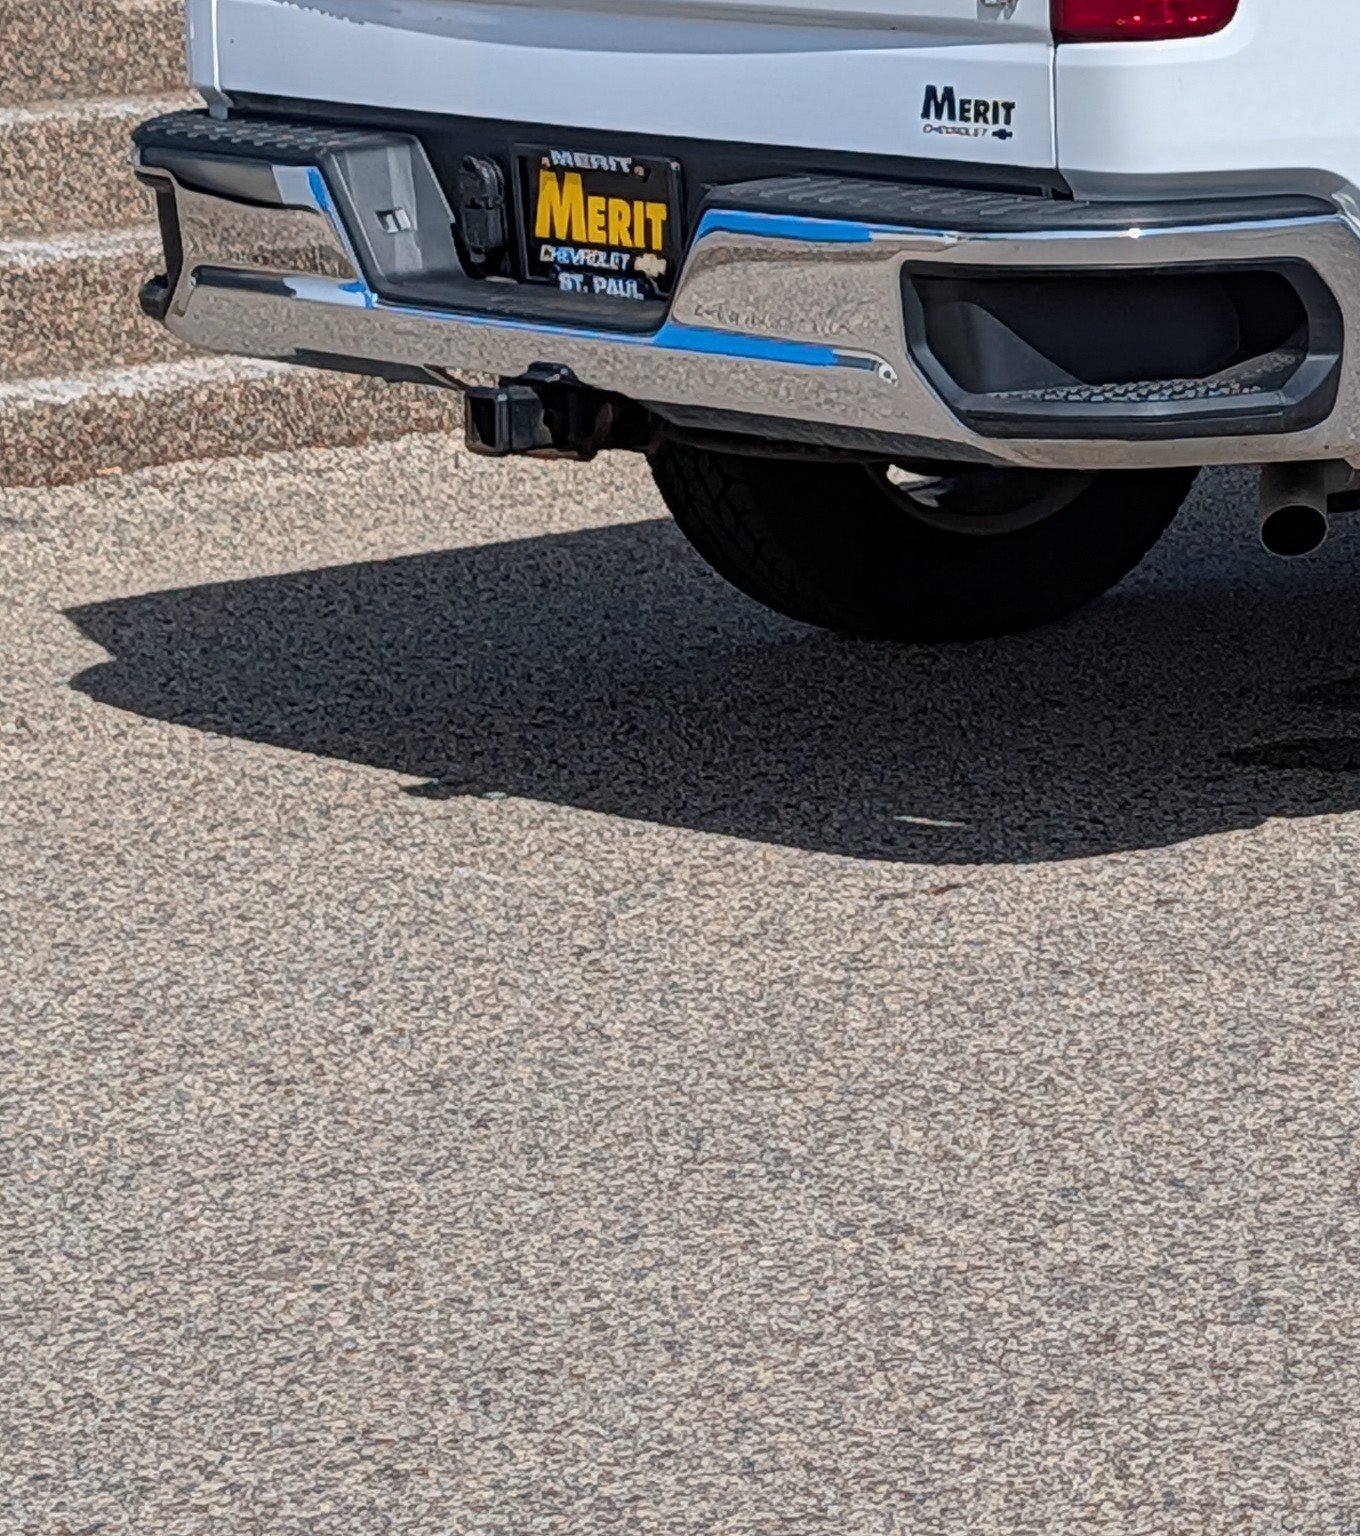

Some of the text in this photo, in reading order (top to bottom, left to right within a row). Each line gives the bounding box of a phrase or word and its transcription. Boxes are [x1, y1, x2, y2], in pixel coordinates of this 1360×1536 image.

[550, 149, 632, 174] MERIT
[539, 244, 631, 271] CHEVROLET
[558, 272, 645, 301] ST. PAUL
